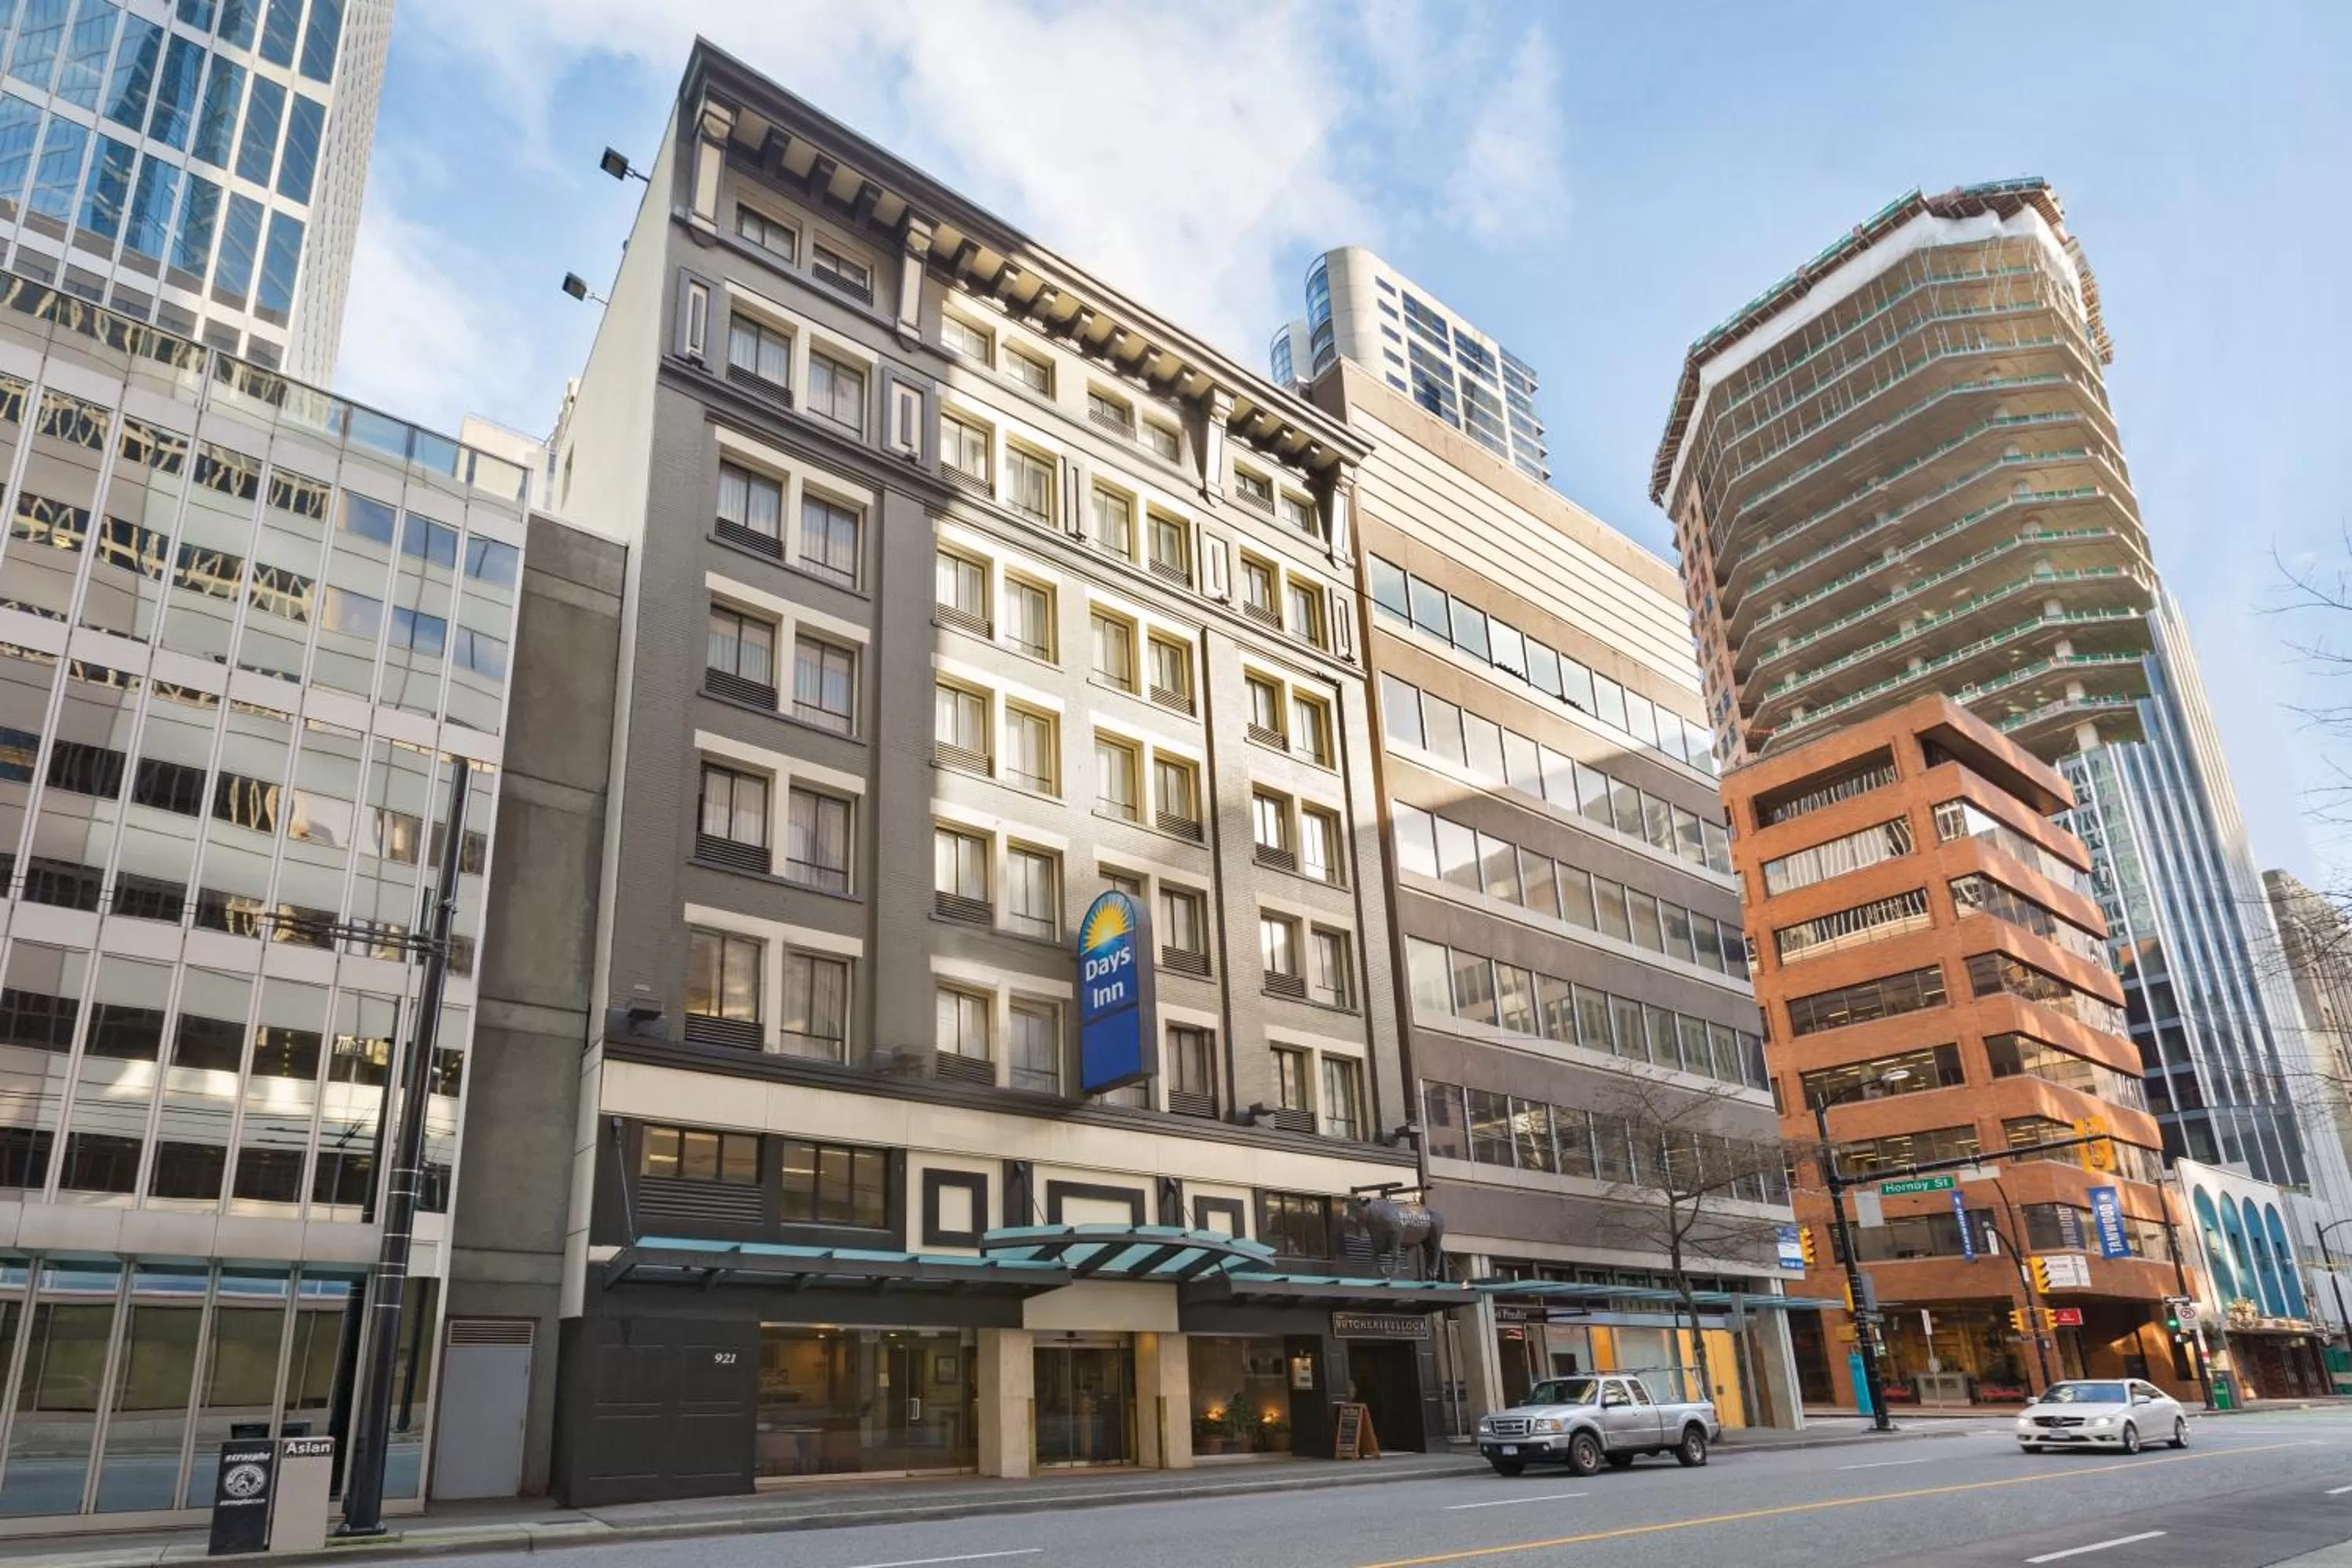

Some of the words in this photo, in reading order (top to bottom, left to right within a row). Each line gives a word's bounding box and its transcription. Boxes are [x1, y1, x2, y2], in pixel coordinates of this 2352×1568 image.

[1085, 946, 1131, 982] Days
[1093, 981, 1124, 1009] Inn
[1885, 1181, 1929, 1192] Hornby
[1934, 1178, 1949, 1188] St
[714, 1352, 737, 1364] 921
[285, 1442, 331, 1454] Asian
